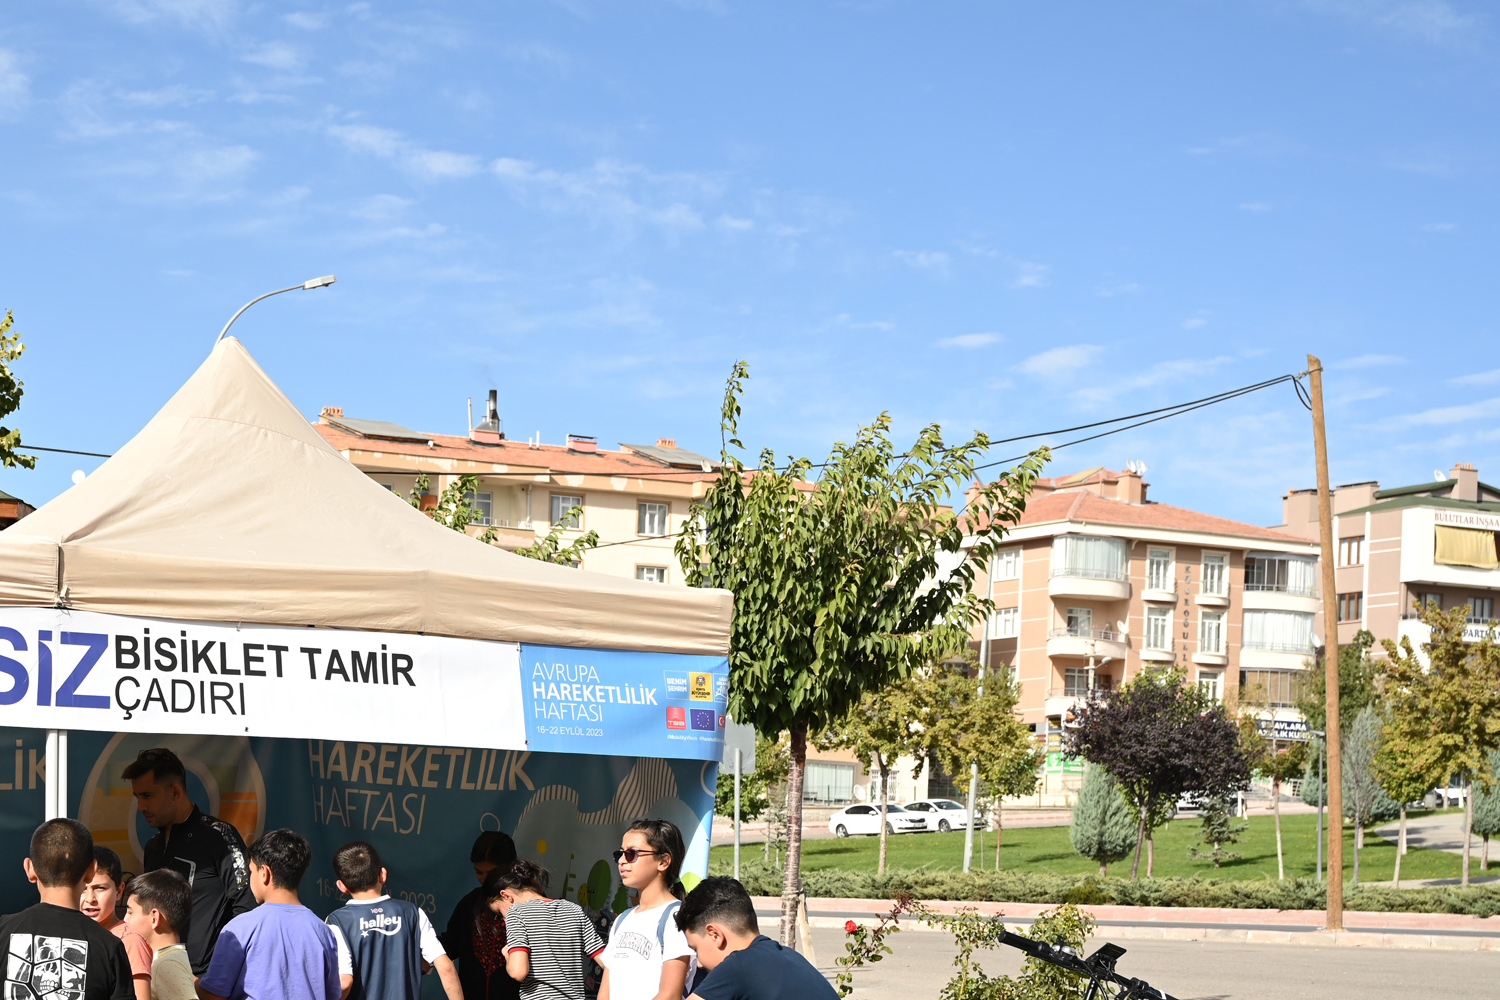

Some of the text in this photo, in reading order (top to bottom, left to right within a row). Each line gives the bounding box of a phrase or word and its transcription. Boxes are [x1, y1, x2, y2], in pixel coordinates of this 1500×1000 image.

[1435, 513, 1474, 525] BULUTLAR
[115, 627, 417, 687] BİSİKLET TAMİR
[532, 662, 601, 684] AVRUPA
[115, 676, 246, 721] ÇADIRI
[532, 681, 658, 706] HAREKETLİLİK
[534, 701, 603, 722] HAFTASI
[560, 725, 585, 736] EYLÜL
[586, 727, 604, 737] 2023
[312, 783, 426, 836] HAFTASI
[360, 914, 402, 936] halley
